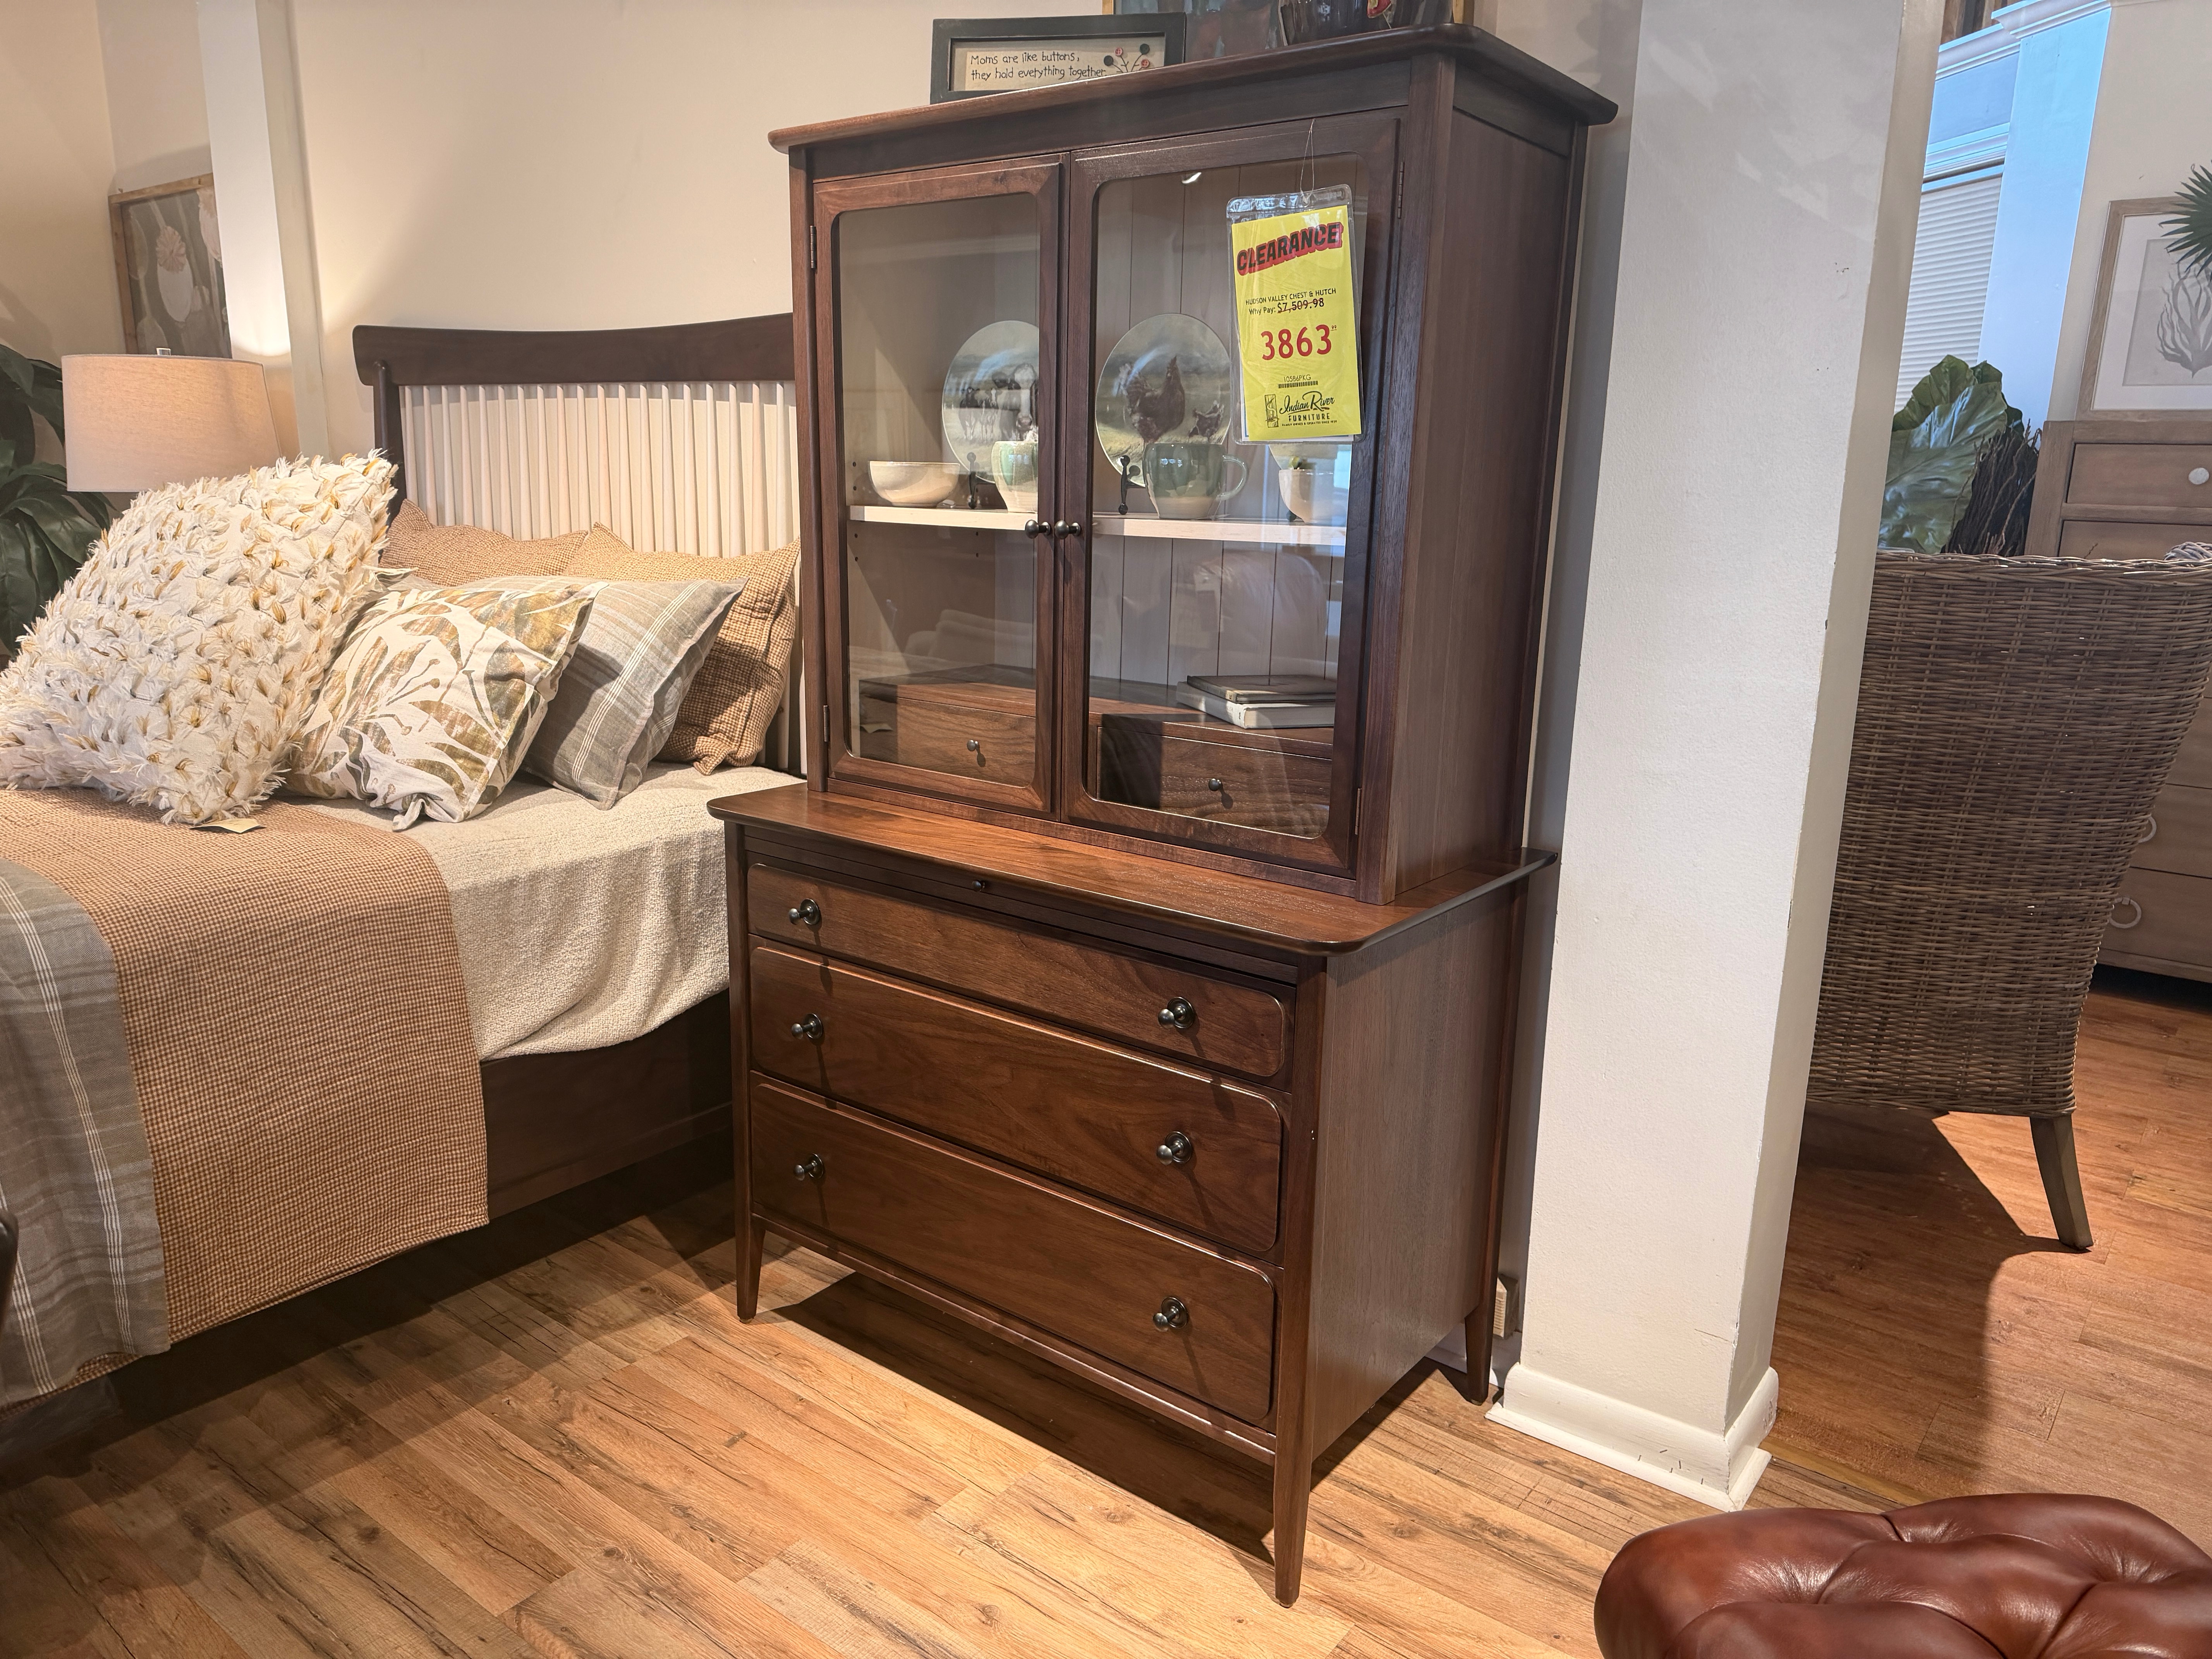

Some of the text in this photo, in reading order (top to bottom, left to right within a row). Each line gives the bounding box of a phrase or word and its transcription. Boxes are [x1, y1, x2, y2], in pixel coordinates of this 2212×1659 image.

[971, 55, 998, 65] Moms
[1022, 52, 1038, 64] like
[1042, 51, 1079, 62] buttons,
[971, 69, 991, 81] they
[995, 66, 1013, 79] hold
[1018, 65, 1065, 80] everything
[1238, 222, 1343, 275] CLEARANCE
[1245, 297, 1267, 305] HUDSON
[1267, 294, 1288, 302] VALLEY
[1289, 291, 1307, 300] CHEST
[1315, 287, 1336, 296] HUTCH
[1249, 297, 1324, 316] Why Pay: $7,509.98
[1261, 324, 1332, 361] 3863
[1283, 374, 1311, 383] 10586PKG
[1279, 391, 1335, 414] Indian River
[1288, 412, 1330, 422] FURNITURE
